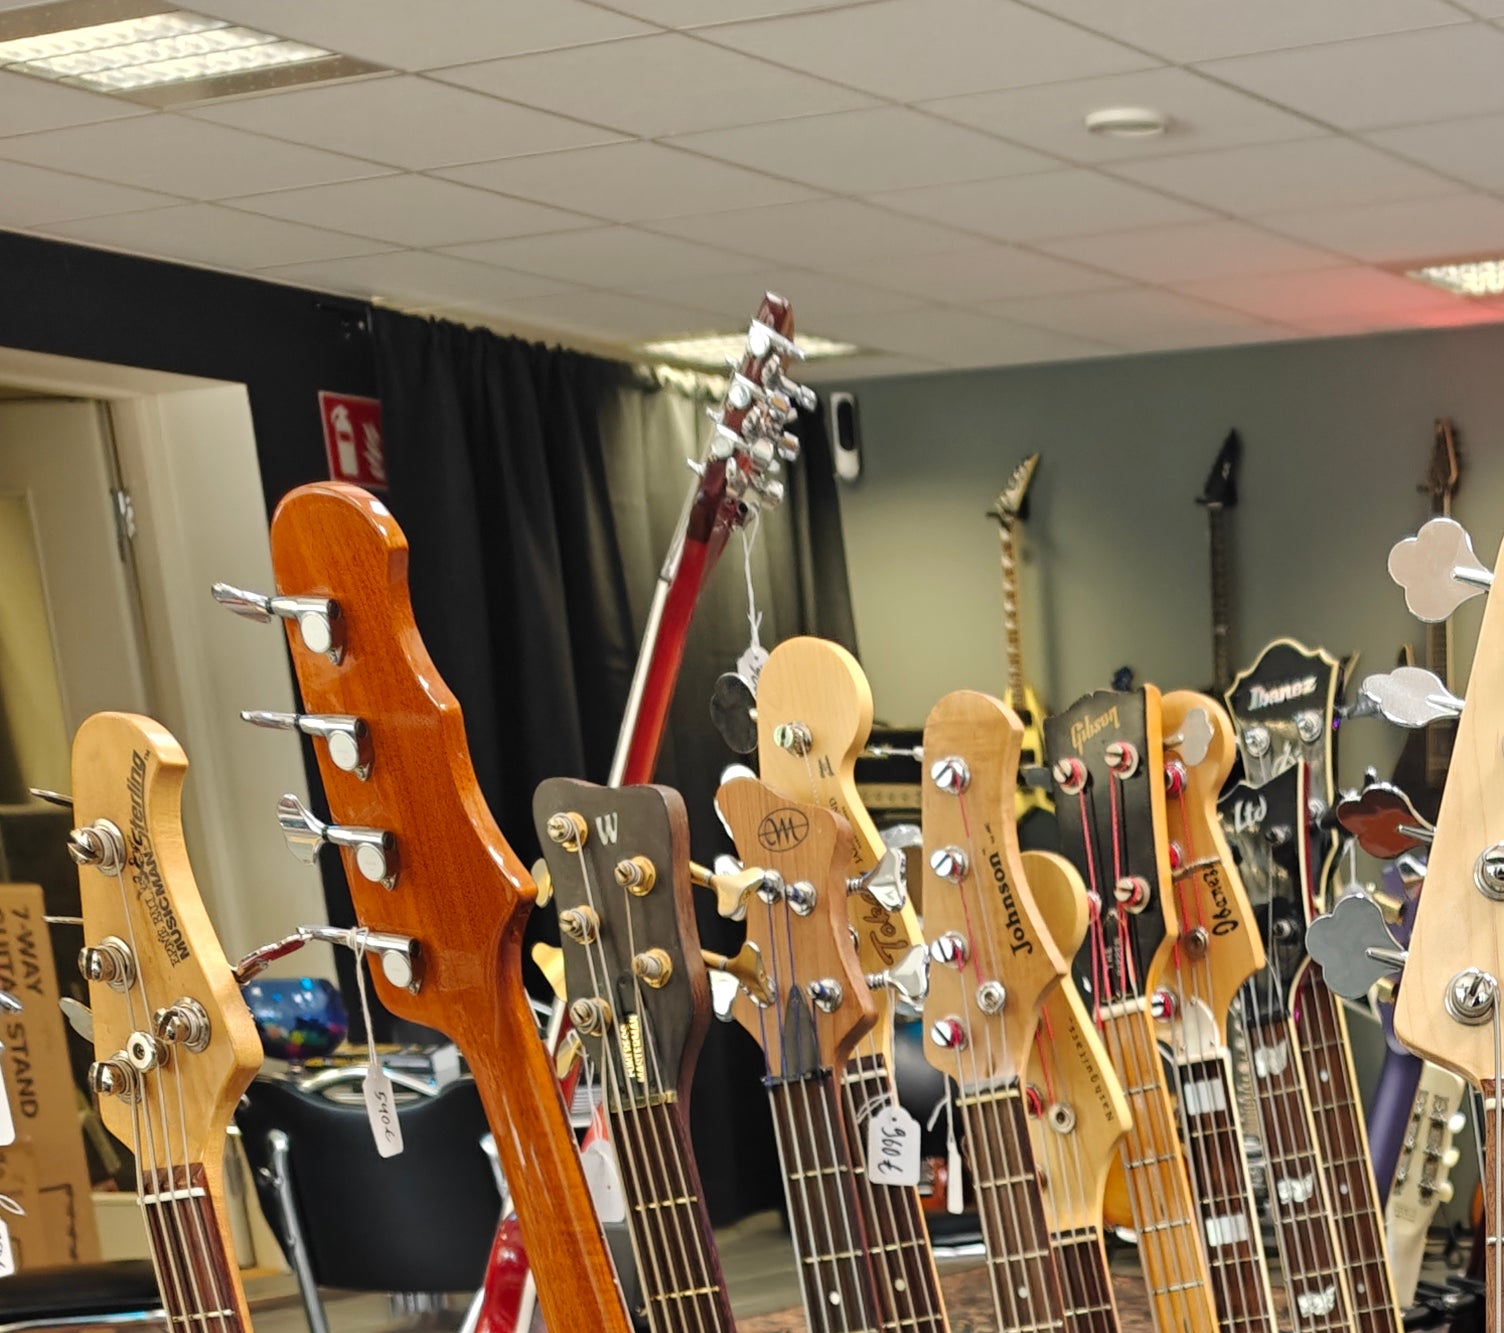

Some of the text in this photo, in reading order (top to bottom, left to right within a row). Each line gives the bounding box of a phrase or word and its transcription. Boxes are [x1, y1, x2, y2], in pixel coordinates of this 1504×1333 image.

[1249, 675, 1318, 711] Ibanez
[1071, 706, 1120, 755] Gibson
[126, 749, 148, 848] Sterling
[596, 812, 618, 845] W
[989, 852, 1032, 957] Johnson
[156, 928, 181, 966] ERNIE
[5, 1023, 38, 1119] STAND
